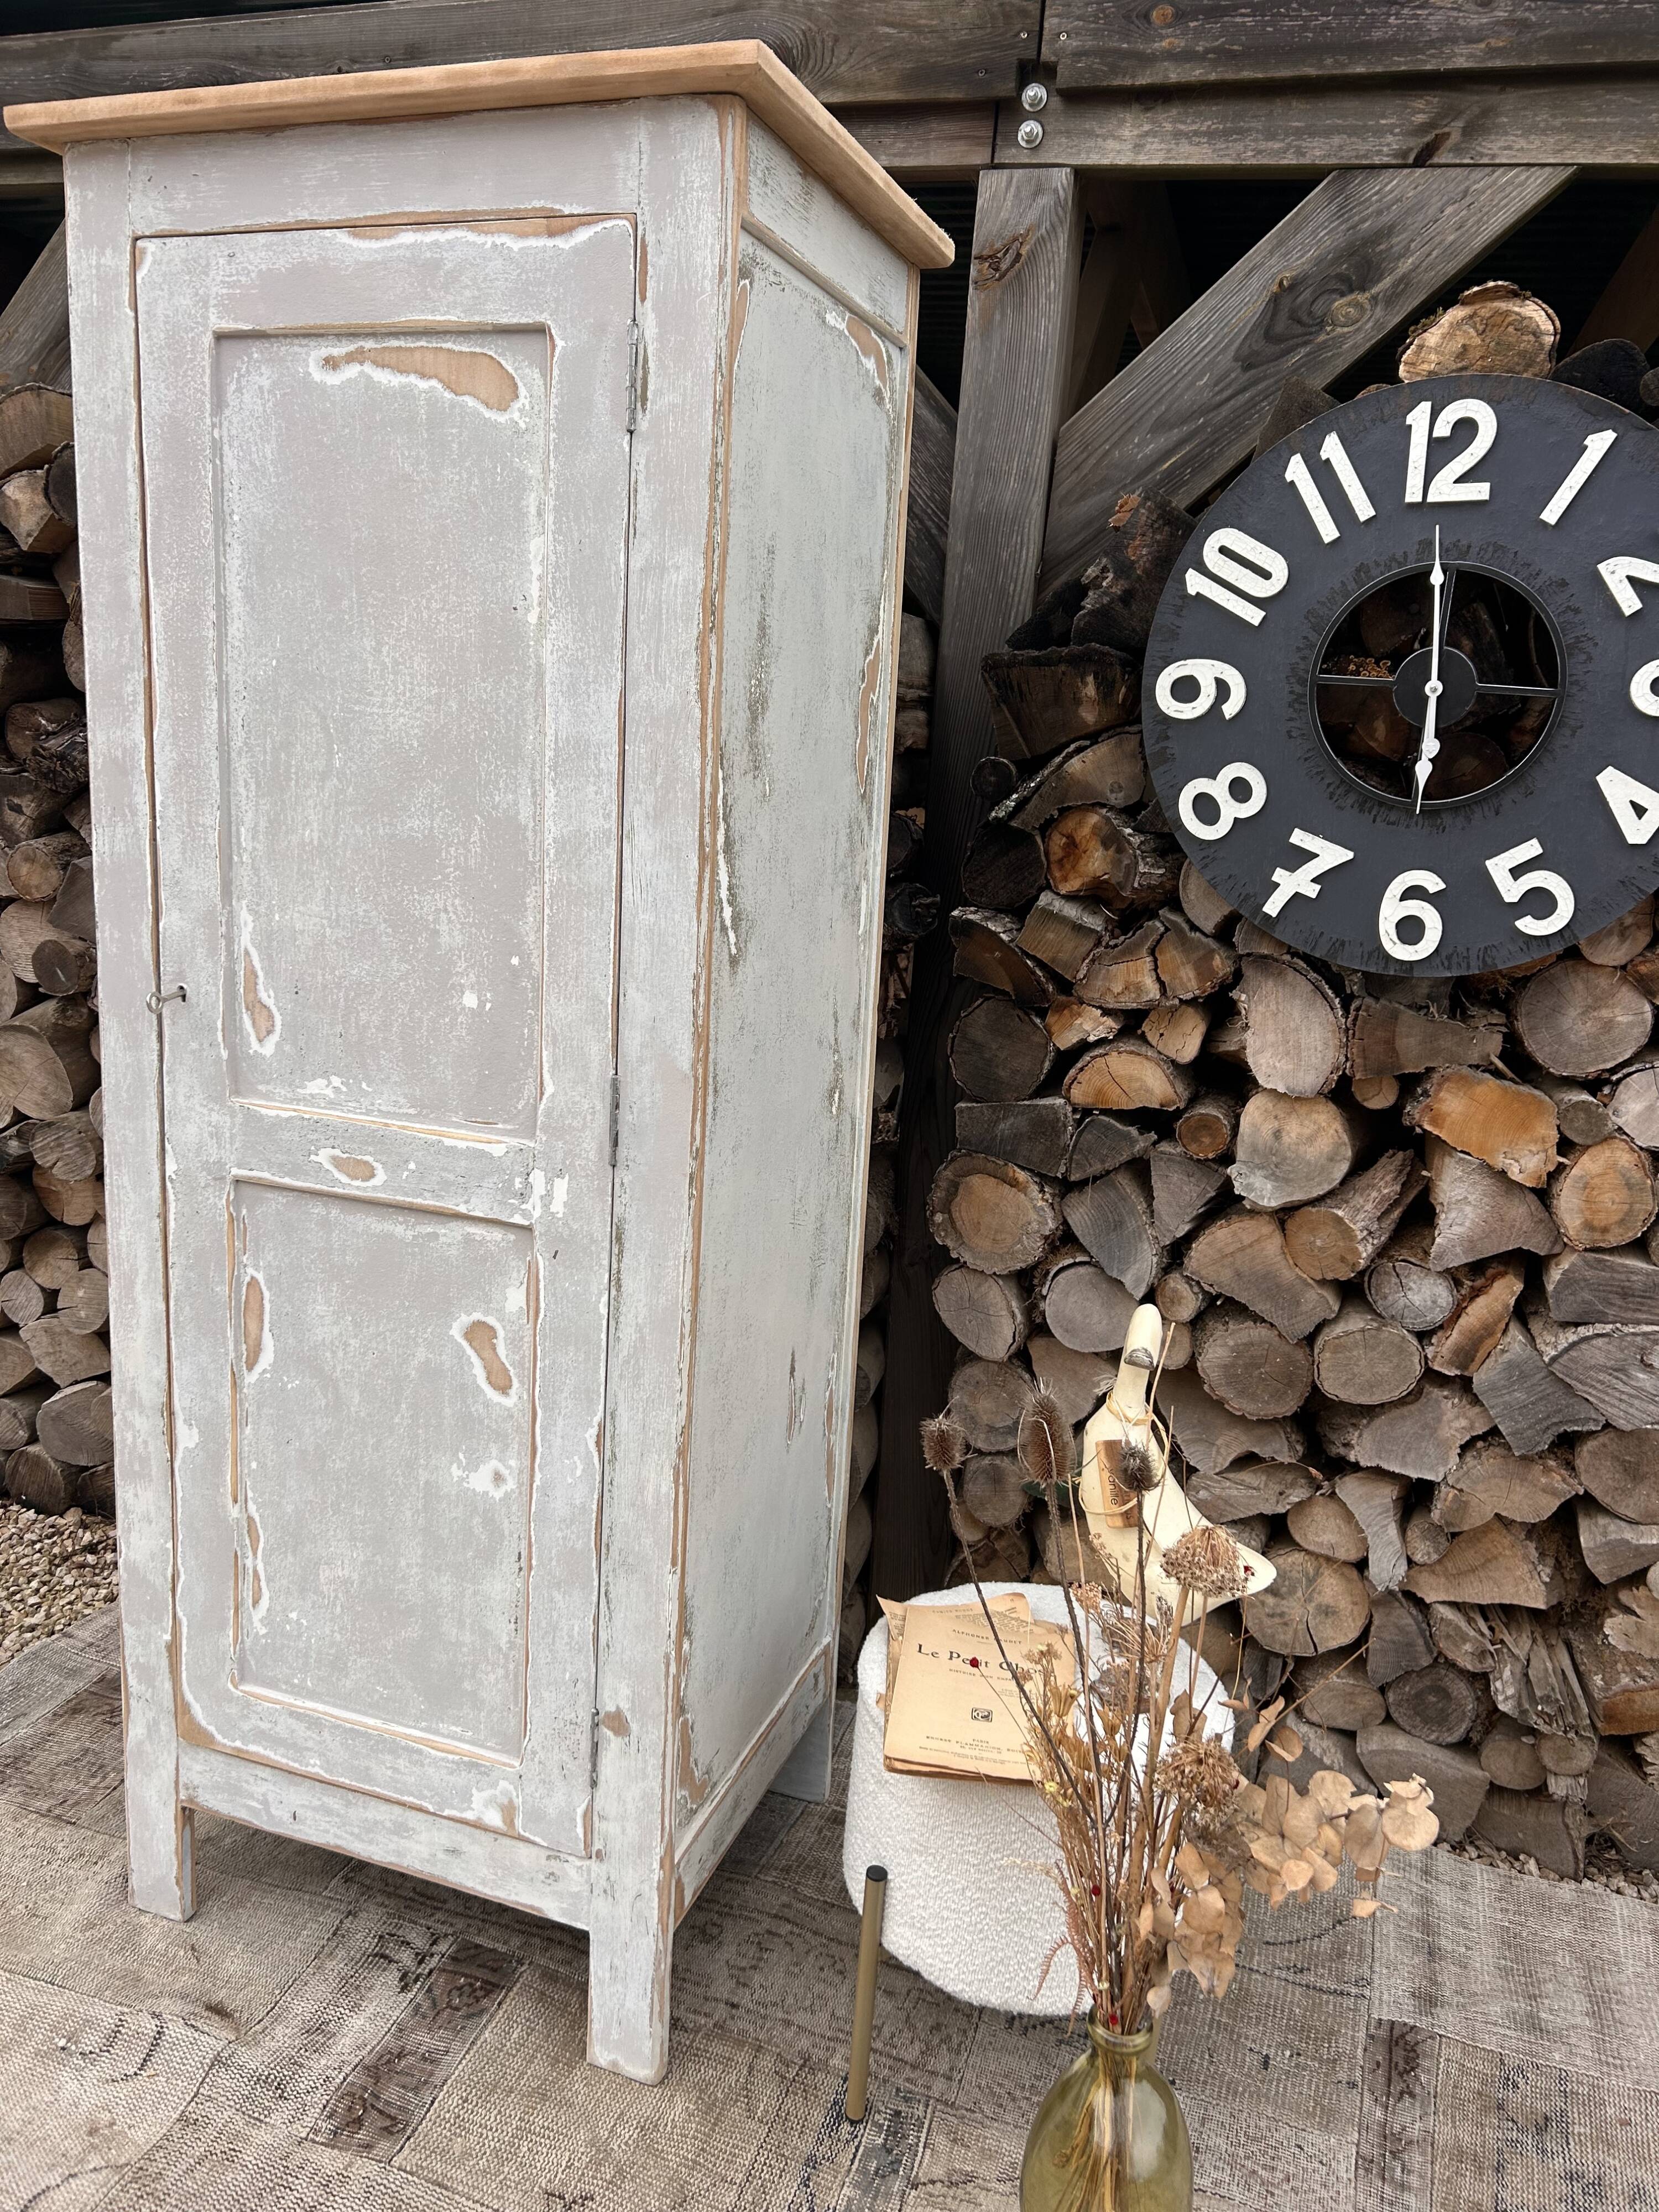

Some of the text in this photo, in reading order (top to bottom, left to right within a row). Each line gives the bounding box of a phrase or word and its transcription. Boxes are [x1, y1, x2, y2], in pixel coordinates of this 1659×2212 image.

[1284, 431, 1376, 544] 11
[1405, 398, 1498, 503] 12
[1539, 429, 1618, 525] 1
[1185, 528, 1288, 627] 10
[1155, 659, 1246, 720] 9
[1178, 762, 1267, 841] 8
[1262, 828, 1354, 917] 7
[1379, 870, 1447, 961] 6
[1485, 837, 1574, 936] 5
[1108, 1468, 1120, 1506] vanille
[917, 1642, 940, 1658] Le
[947, 1650, 990, 1668] Peit
